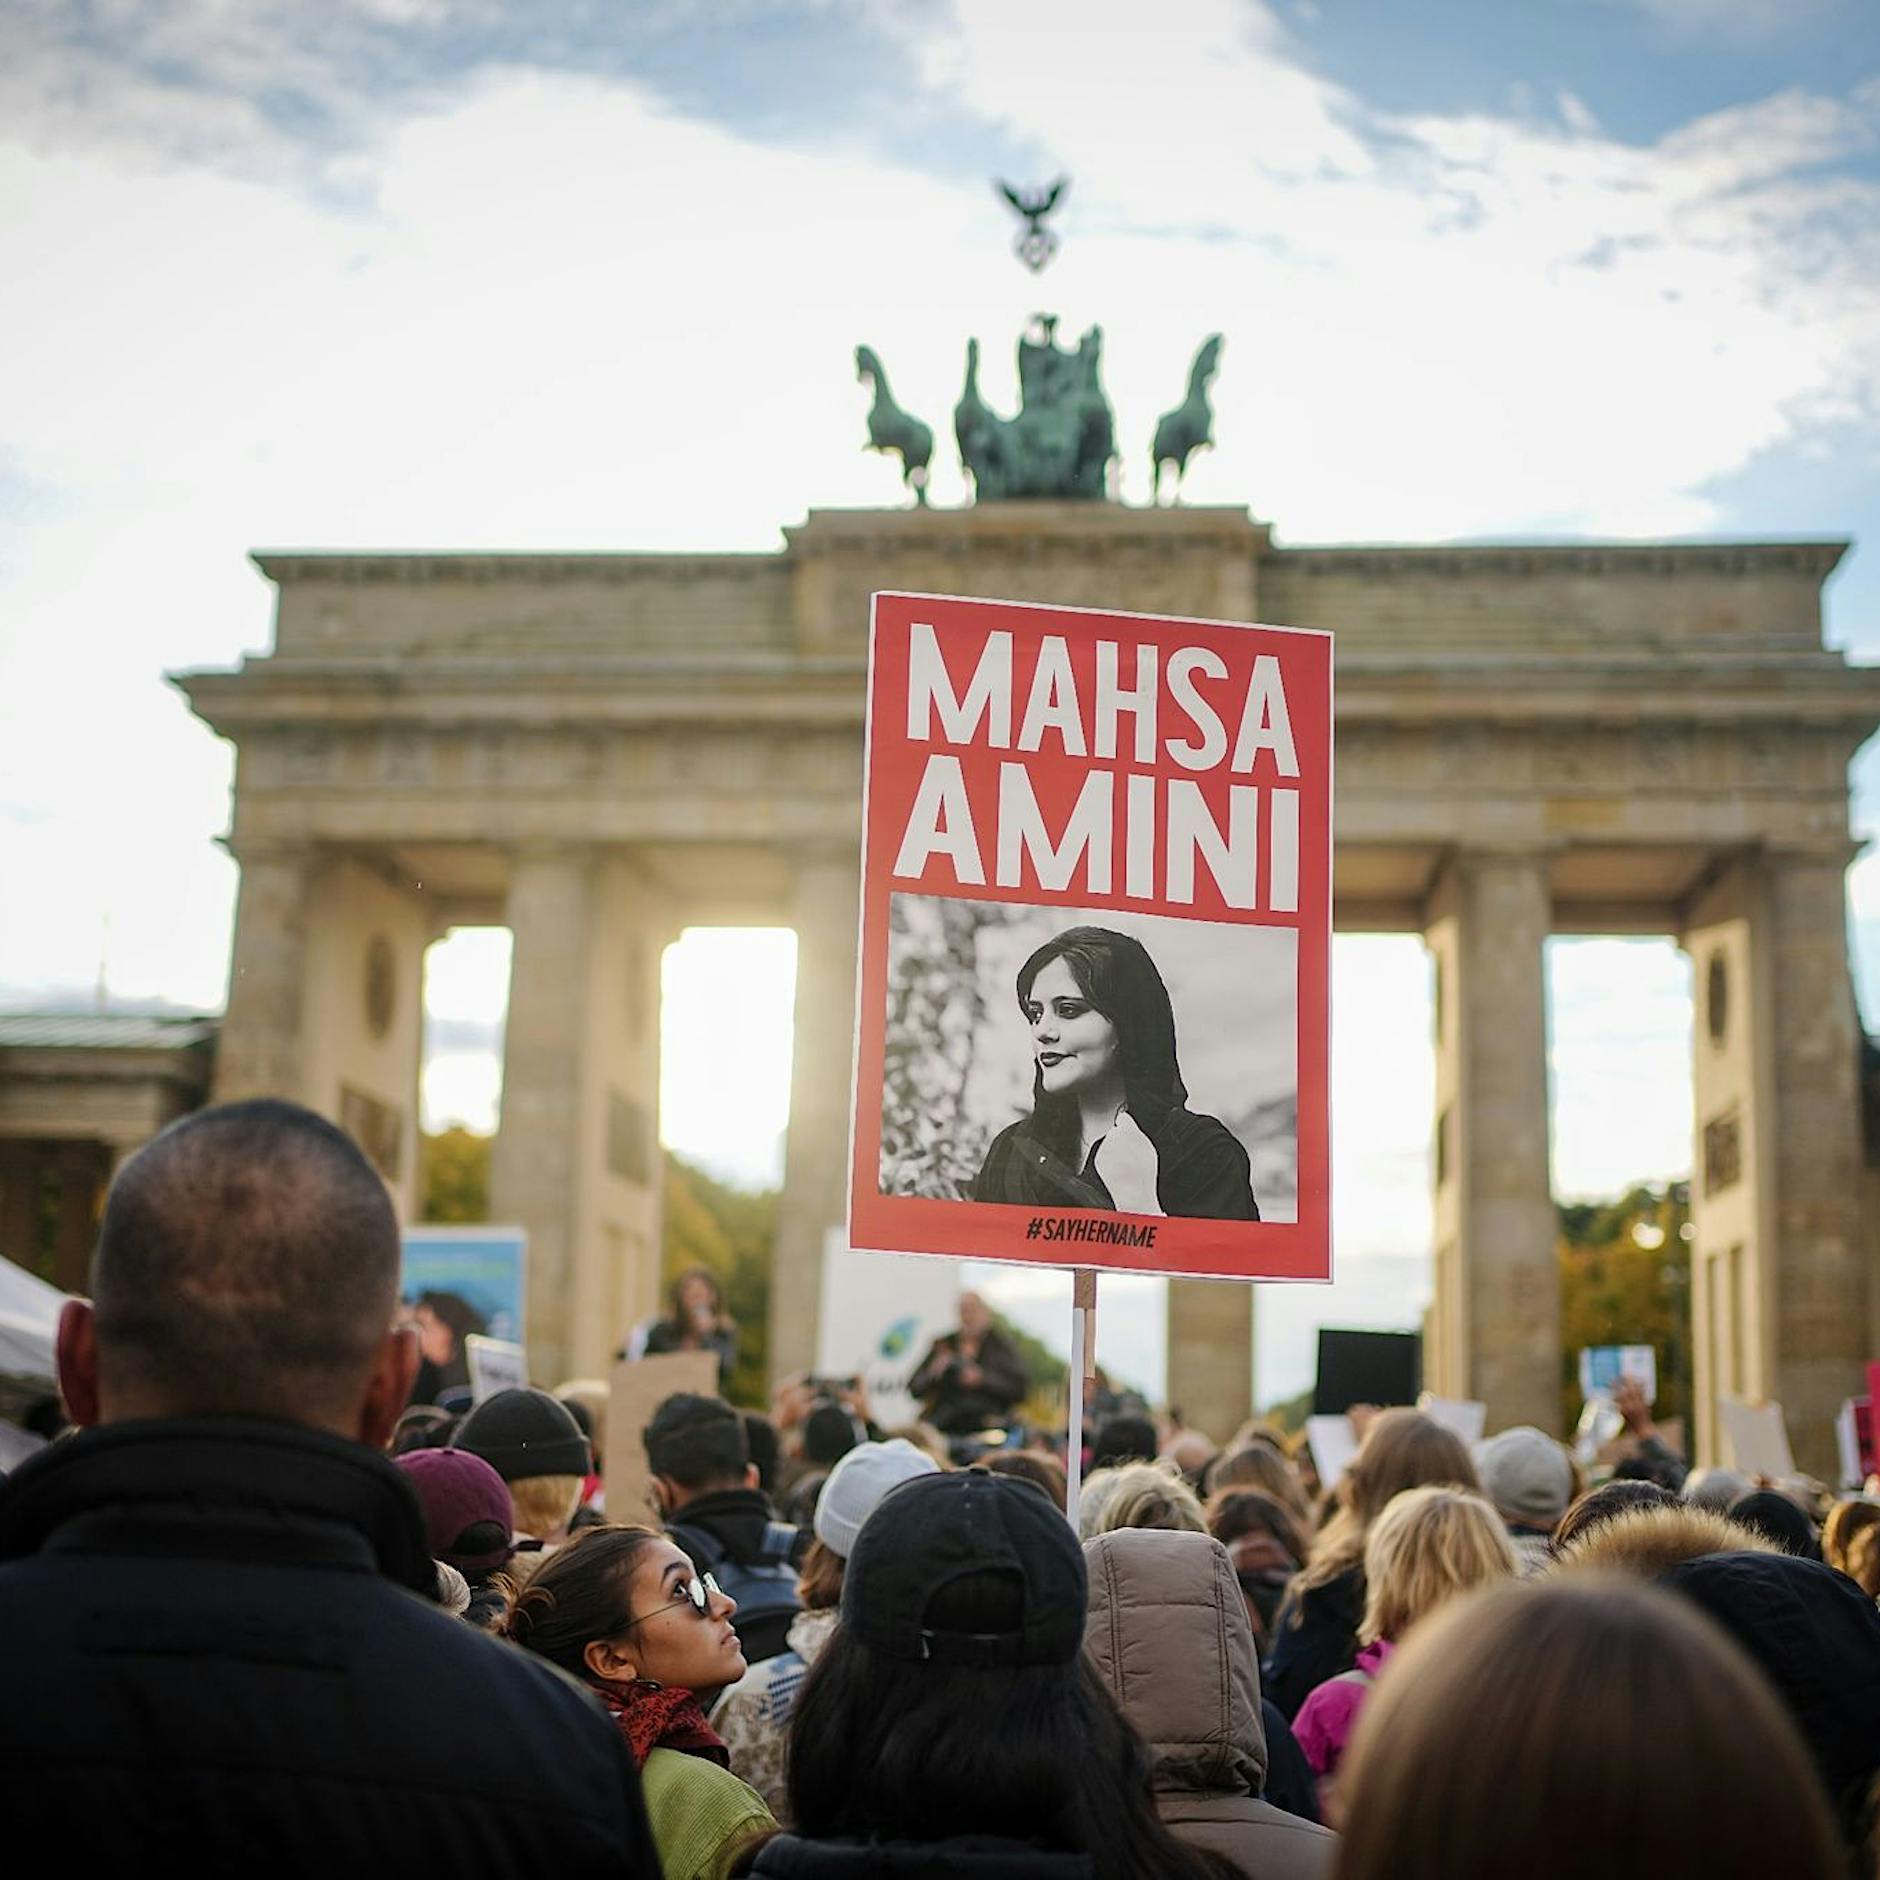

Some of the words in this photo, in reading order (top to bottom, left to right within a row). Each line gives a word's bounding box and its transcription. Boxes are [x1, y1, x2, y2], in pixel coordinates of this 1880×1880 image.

[907, 623, 1300, 778] MAHSA
[893, 754, 1299, 913] AMINI
[1026, 1217, 1158, 1248] #SAYHERNAME
